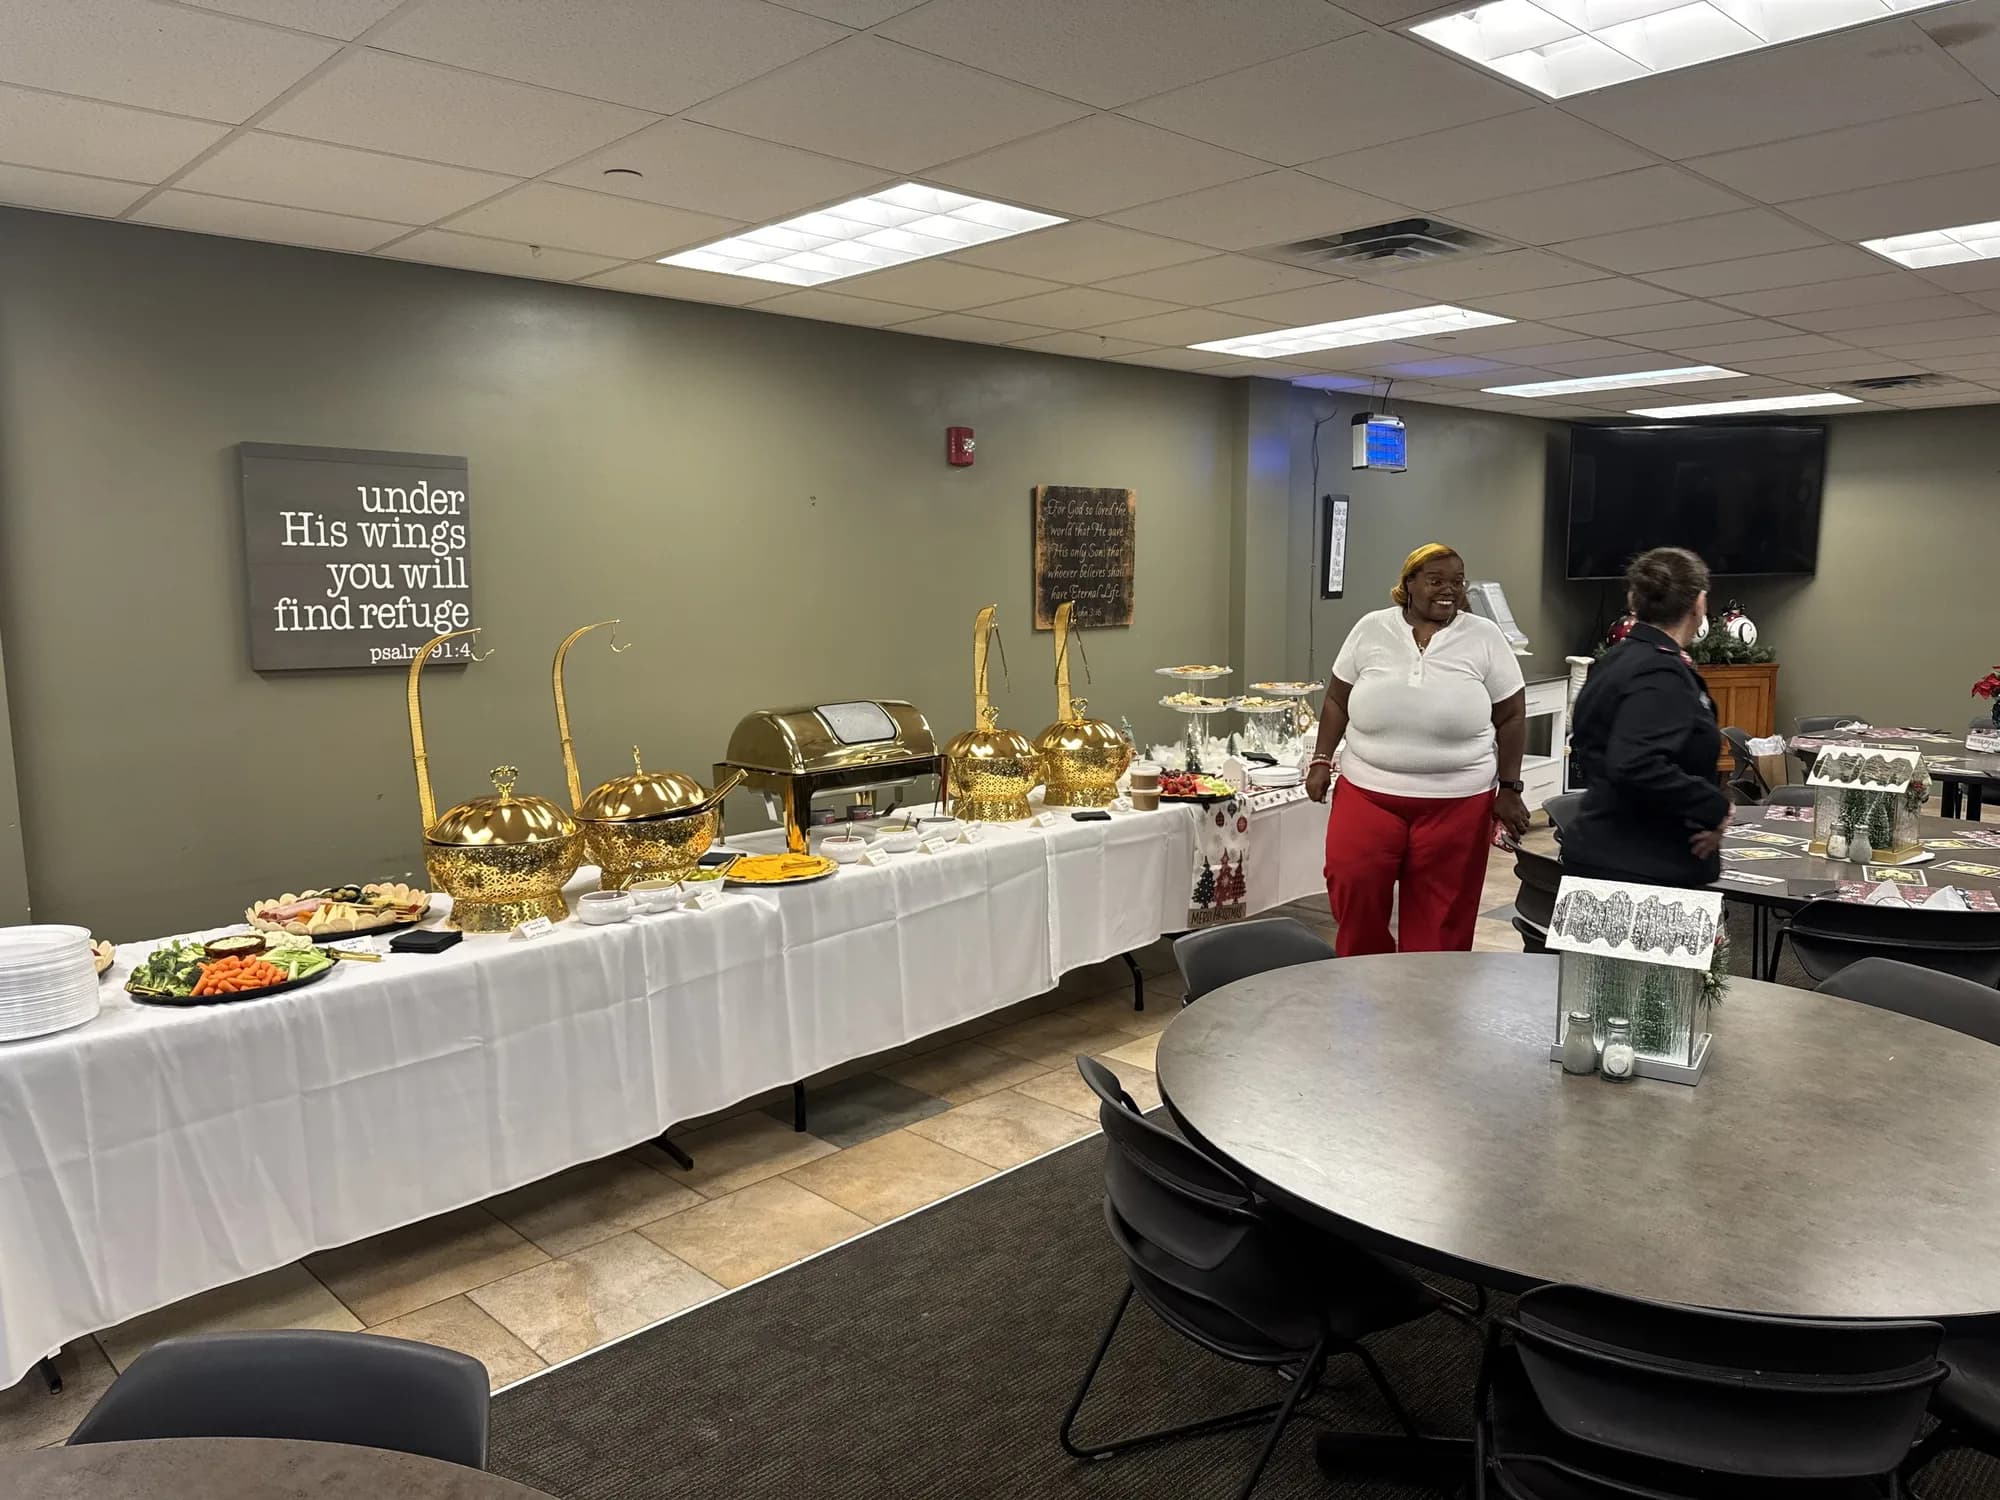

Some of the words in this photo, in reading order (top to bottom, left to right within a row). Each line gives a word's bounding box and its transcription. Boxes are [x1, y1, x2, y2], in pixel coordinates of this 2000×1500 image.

[357, 480, 465, 516] under
[1045, 498, 1066, 515] For
[1067, 499, 1088, 518] God
[1085, 506, 1093, 515] so
[1095, 501, 1116, 516] loved
[1115, 502, 1127, 516] the
[279, 511, 348, 548] His
[356, 516, 467, 557] wings
[1050, 521, 1073, 537] world
[1074, 521, 1090, 537] that
[1091, 521, 1106, 537] He
[1106, 527, 1124, 542] gave
[1049, 542, 1069, 558] His
[1070, 543, 1087, 563] only
[1107, 543, 1123, 558] that
[326, 561, 395, 599] you
[398, 556, 469, 590] will
[1047, 564, 1078, 578] whoever
[1079, 563, 1106, 578] believes
[1051, 585, 1068, 600] have
[1069, 584, 1103, 600] Eternal
[273, 596, 355, 632] find
[358, 595, 469, 636] refuge
[369, 643, 423, 665] psalm
[430, 642, 471, 659] 91:4
